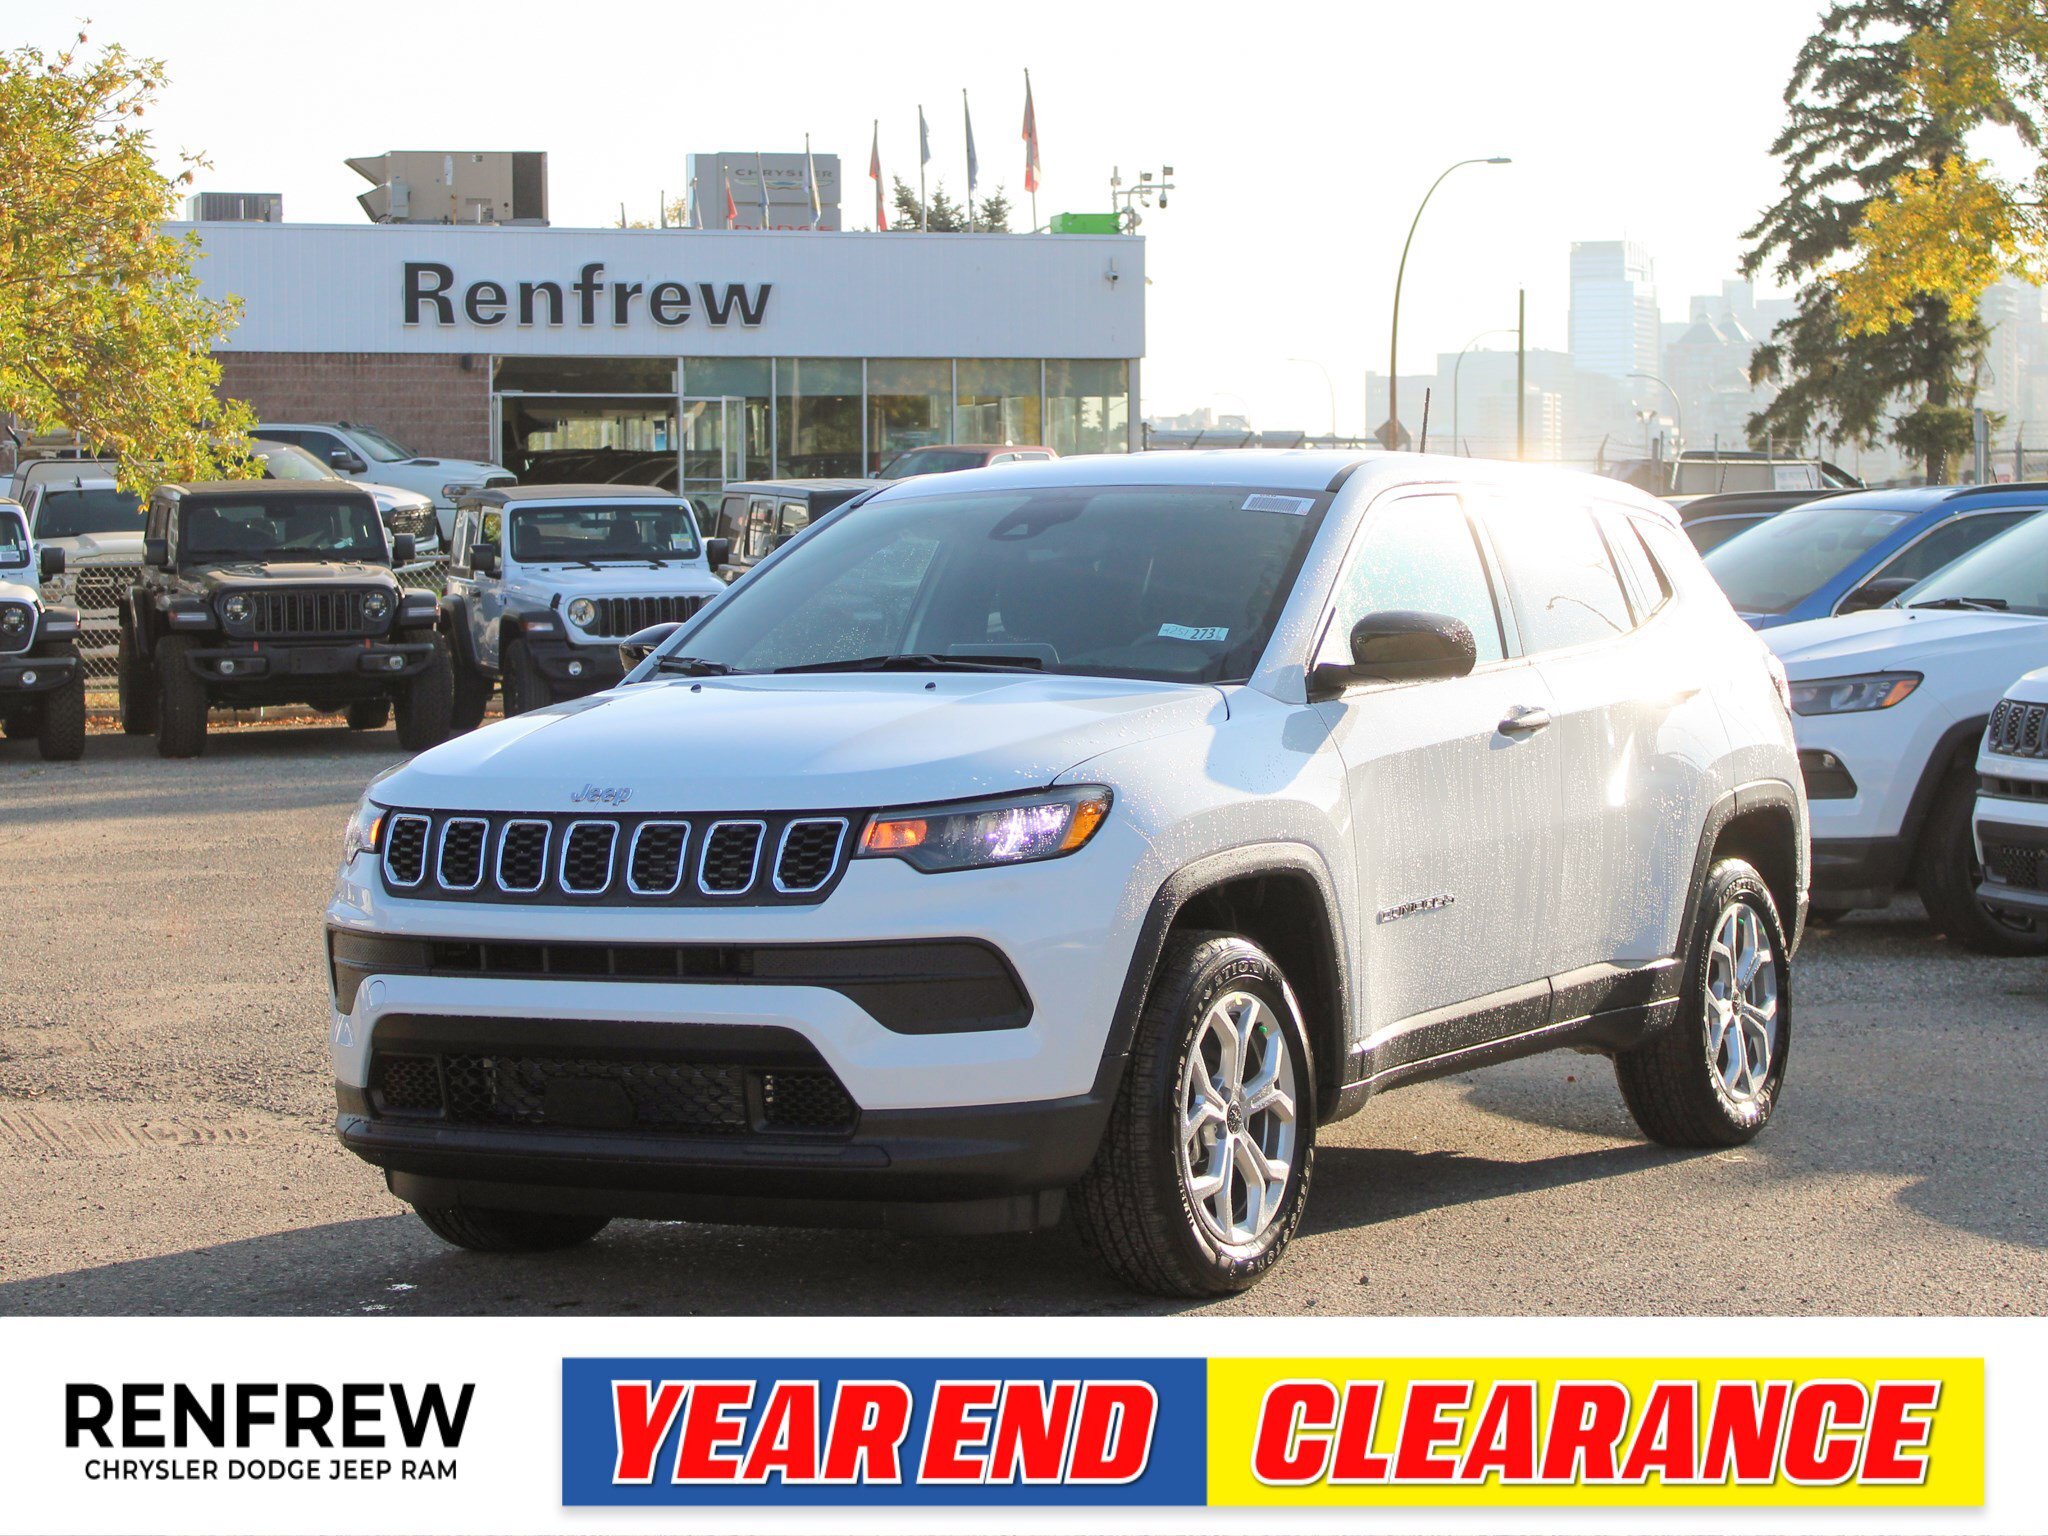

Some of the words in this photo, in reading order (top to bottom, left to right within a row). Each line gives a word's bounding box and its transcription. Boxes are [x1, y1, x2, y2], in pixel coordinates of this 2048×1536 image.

[402, 260, 774, 328] Renfrew
[1190, 628, 1216, 640] 273
[570, 783, 633, 807] Jeep
